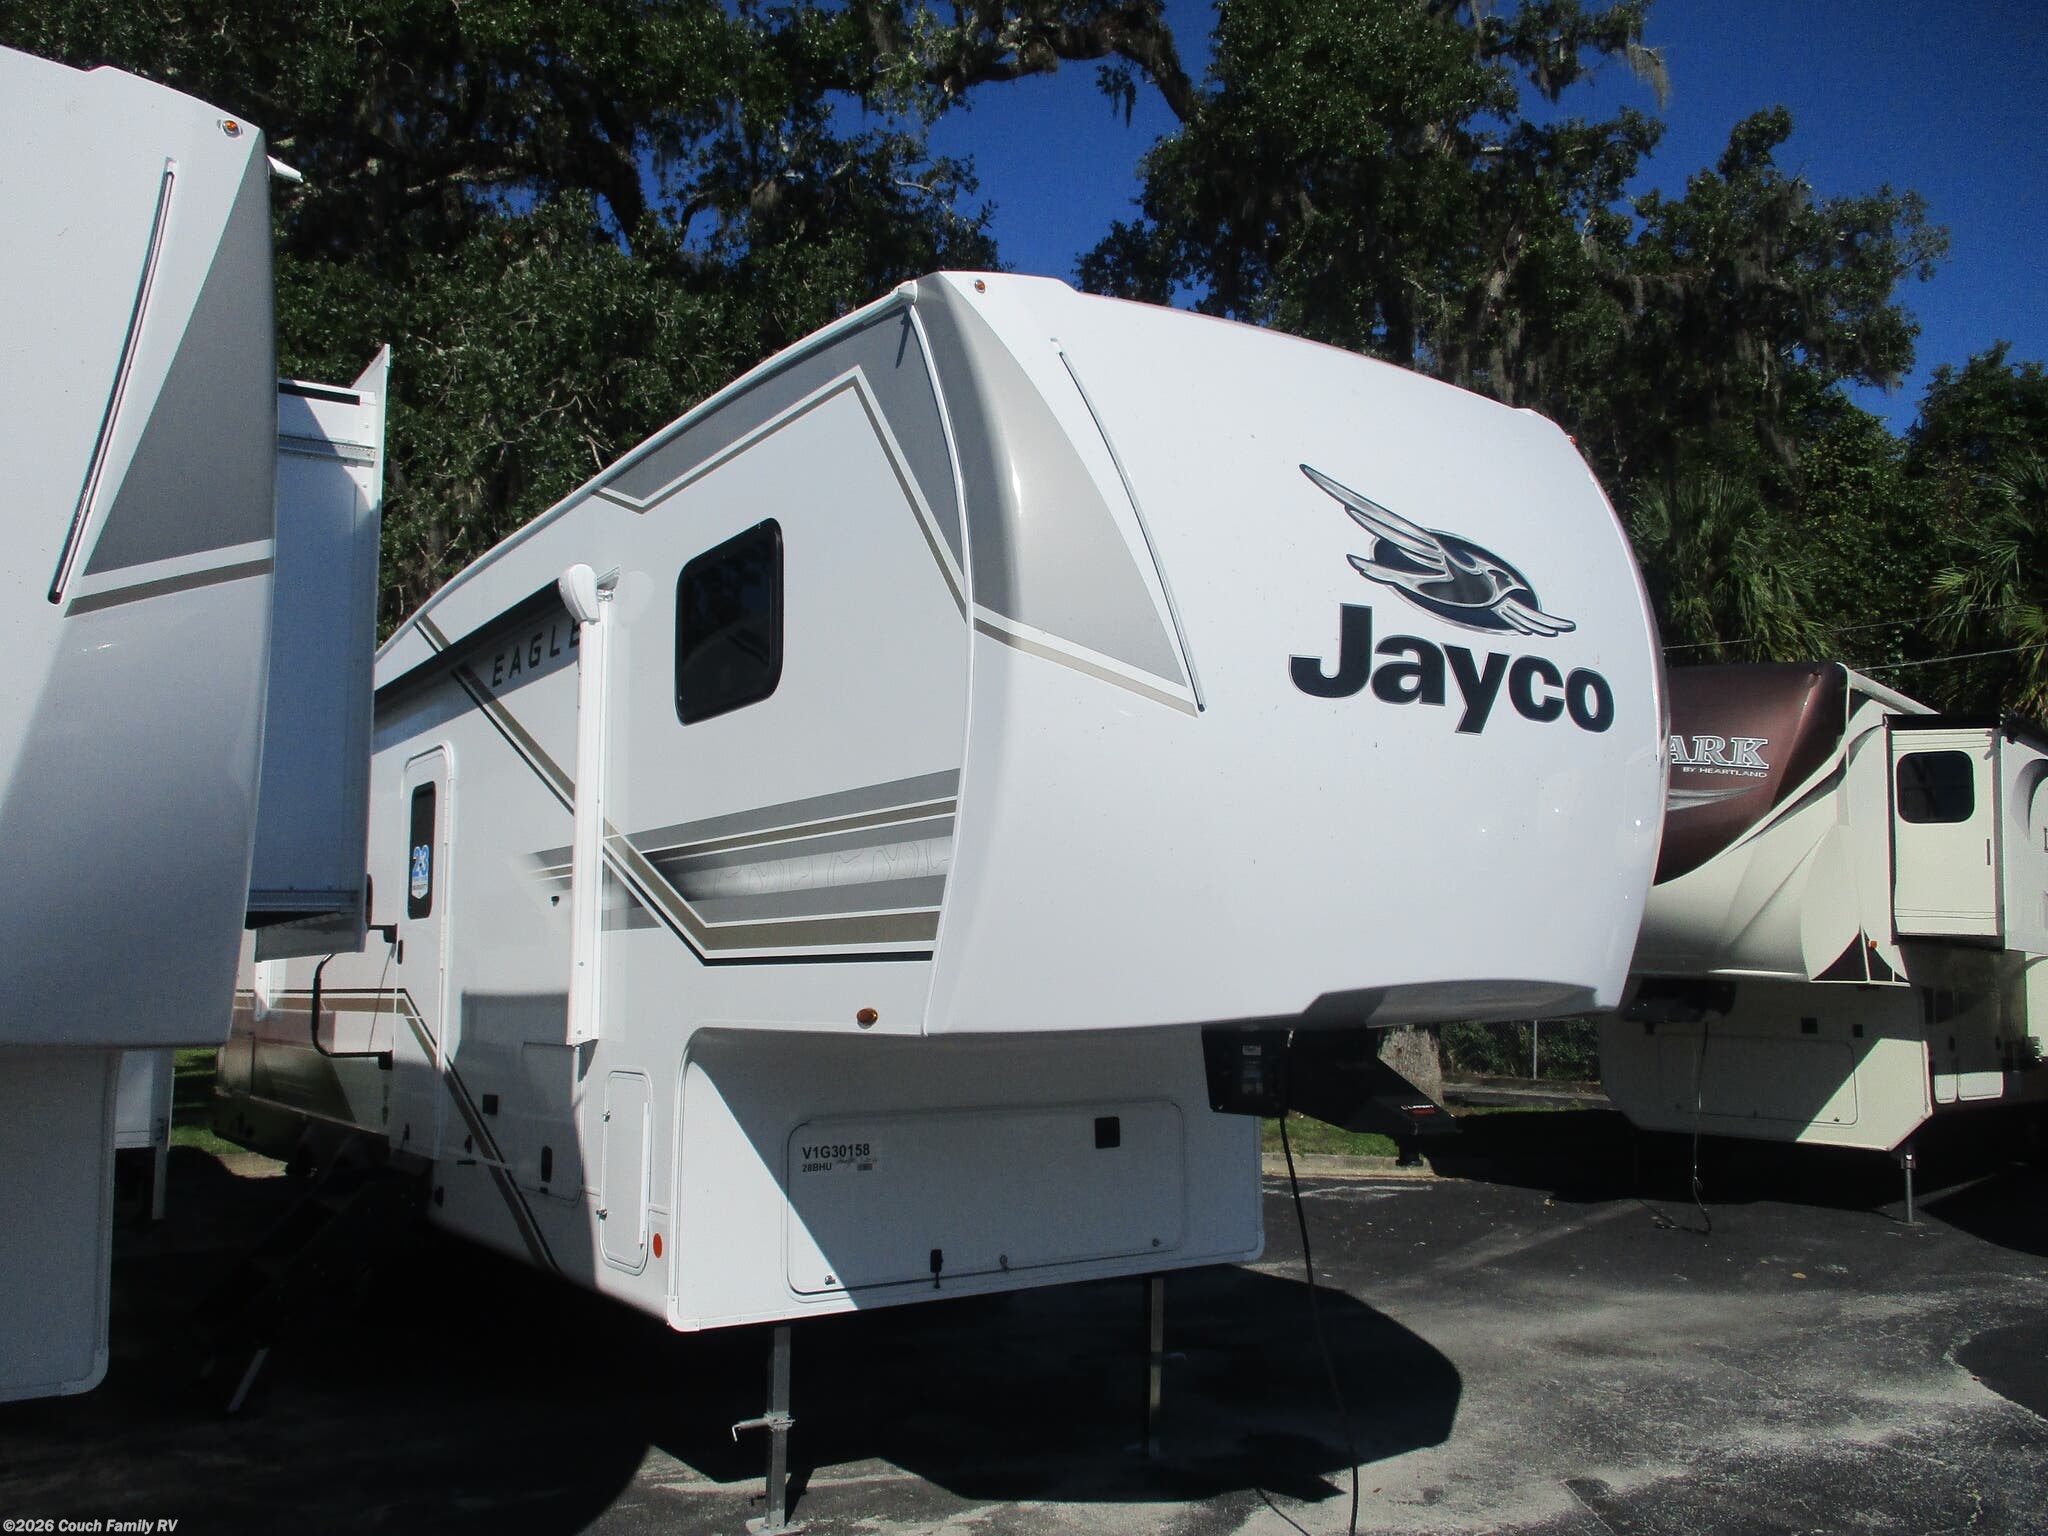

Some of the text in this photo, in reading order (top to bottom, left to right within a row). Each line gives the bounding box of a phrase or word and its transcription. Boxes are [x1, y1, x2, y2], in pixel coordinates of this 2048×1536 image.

[492, 619, 580, 688] EAGLE
[1289, 602, 1616, 736] Jayco
[1699, 767, 1768, 778] HEARTLAND
[802, 1143, 870, 1159] V1G30158
